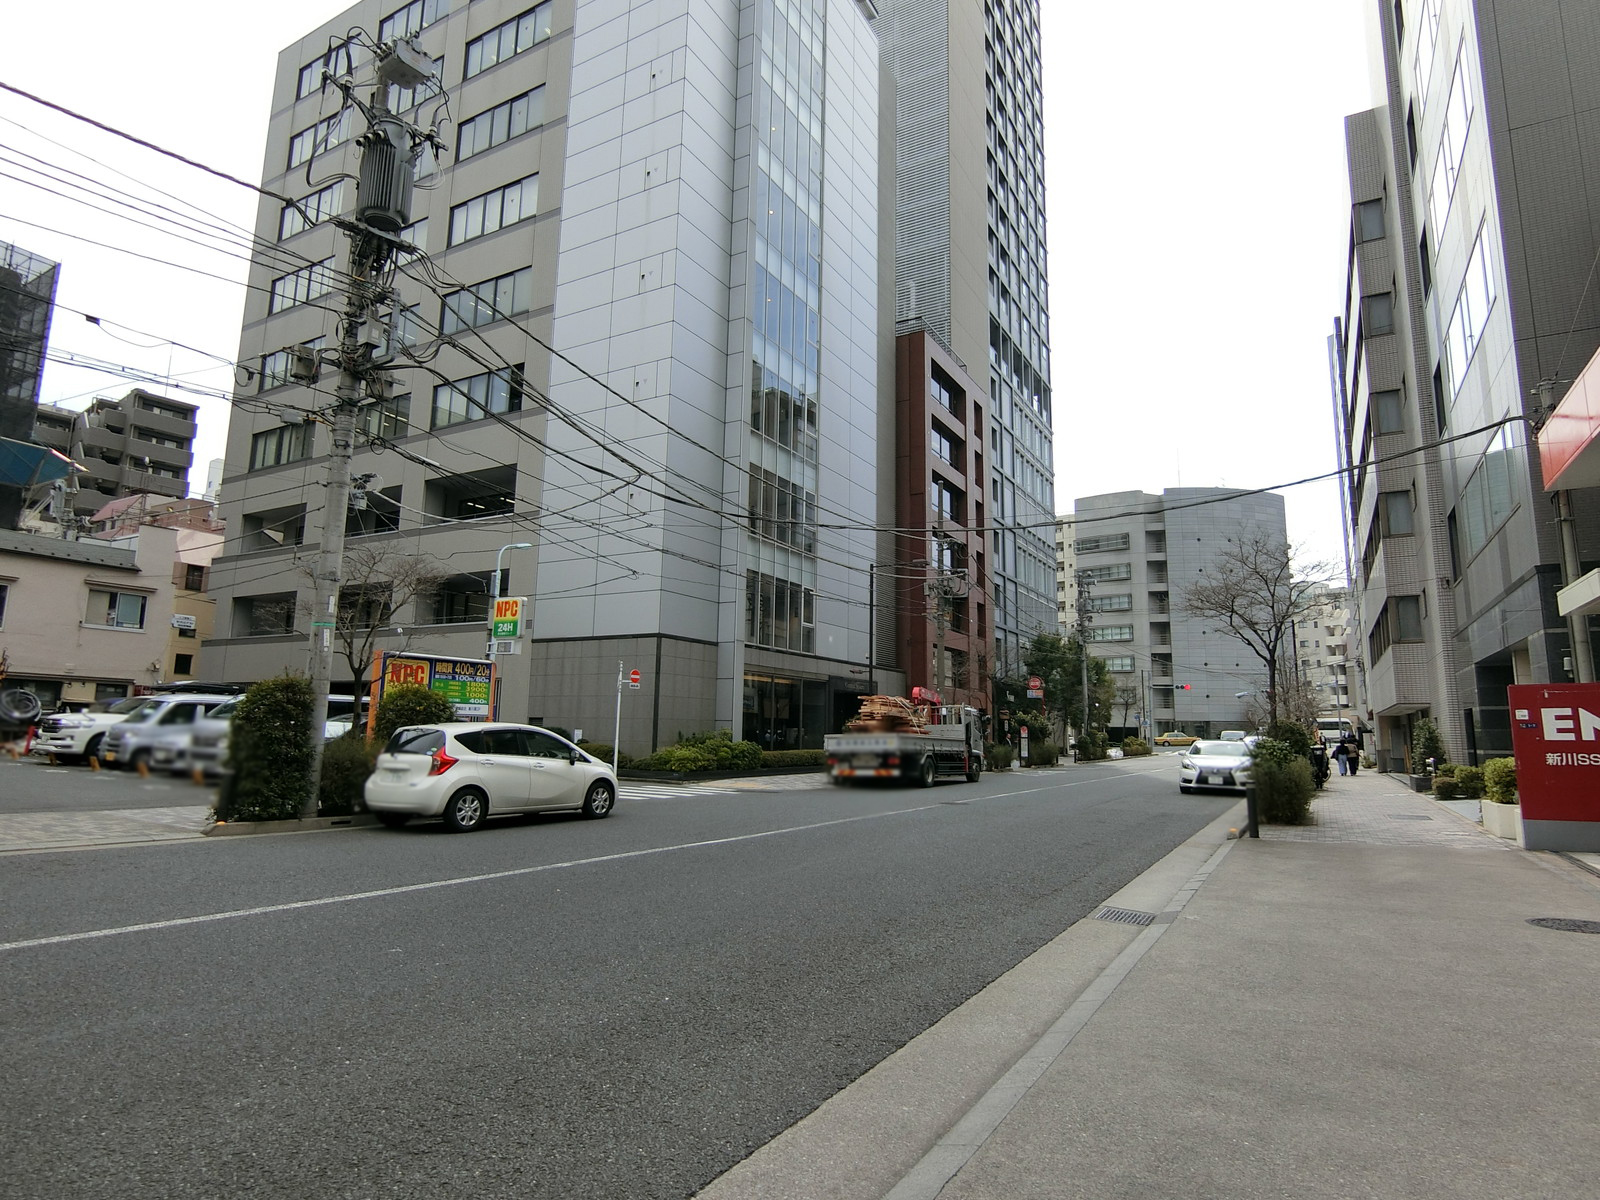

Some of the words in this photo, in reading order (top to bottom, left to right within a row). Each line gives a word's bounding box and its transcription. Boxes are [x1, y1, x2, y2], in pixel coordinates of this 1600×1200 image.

[496, 600, 518, 617] NPC
[498, 623, 513, 632] 24H
[390, 663, 424, 684] NPC
